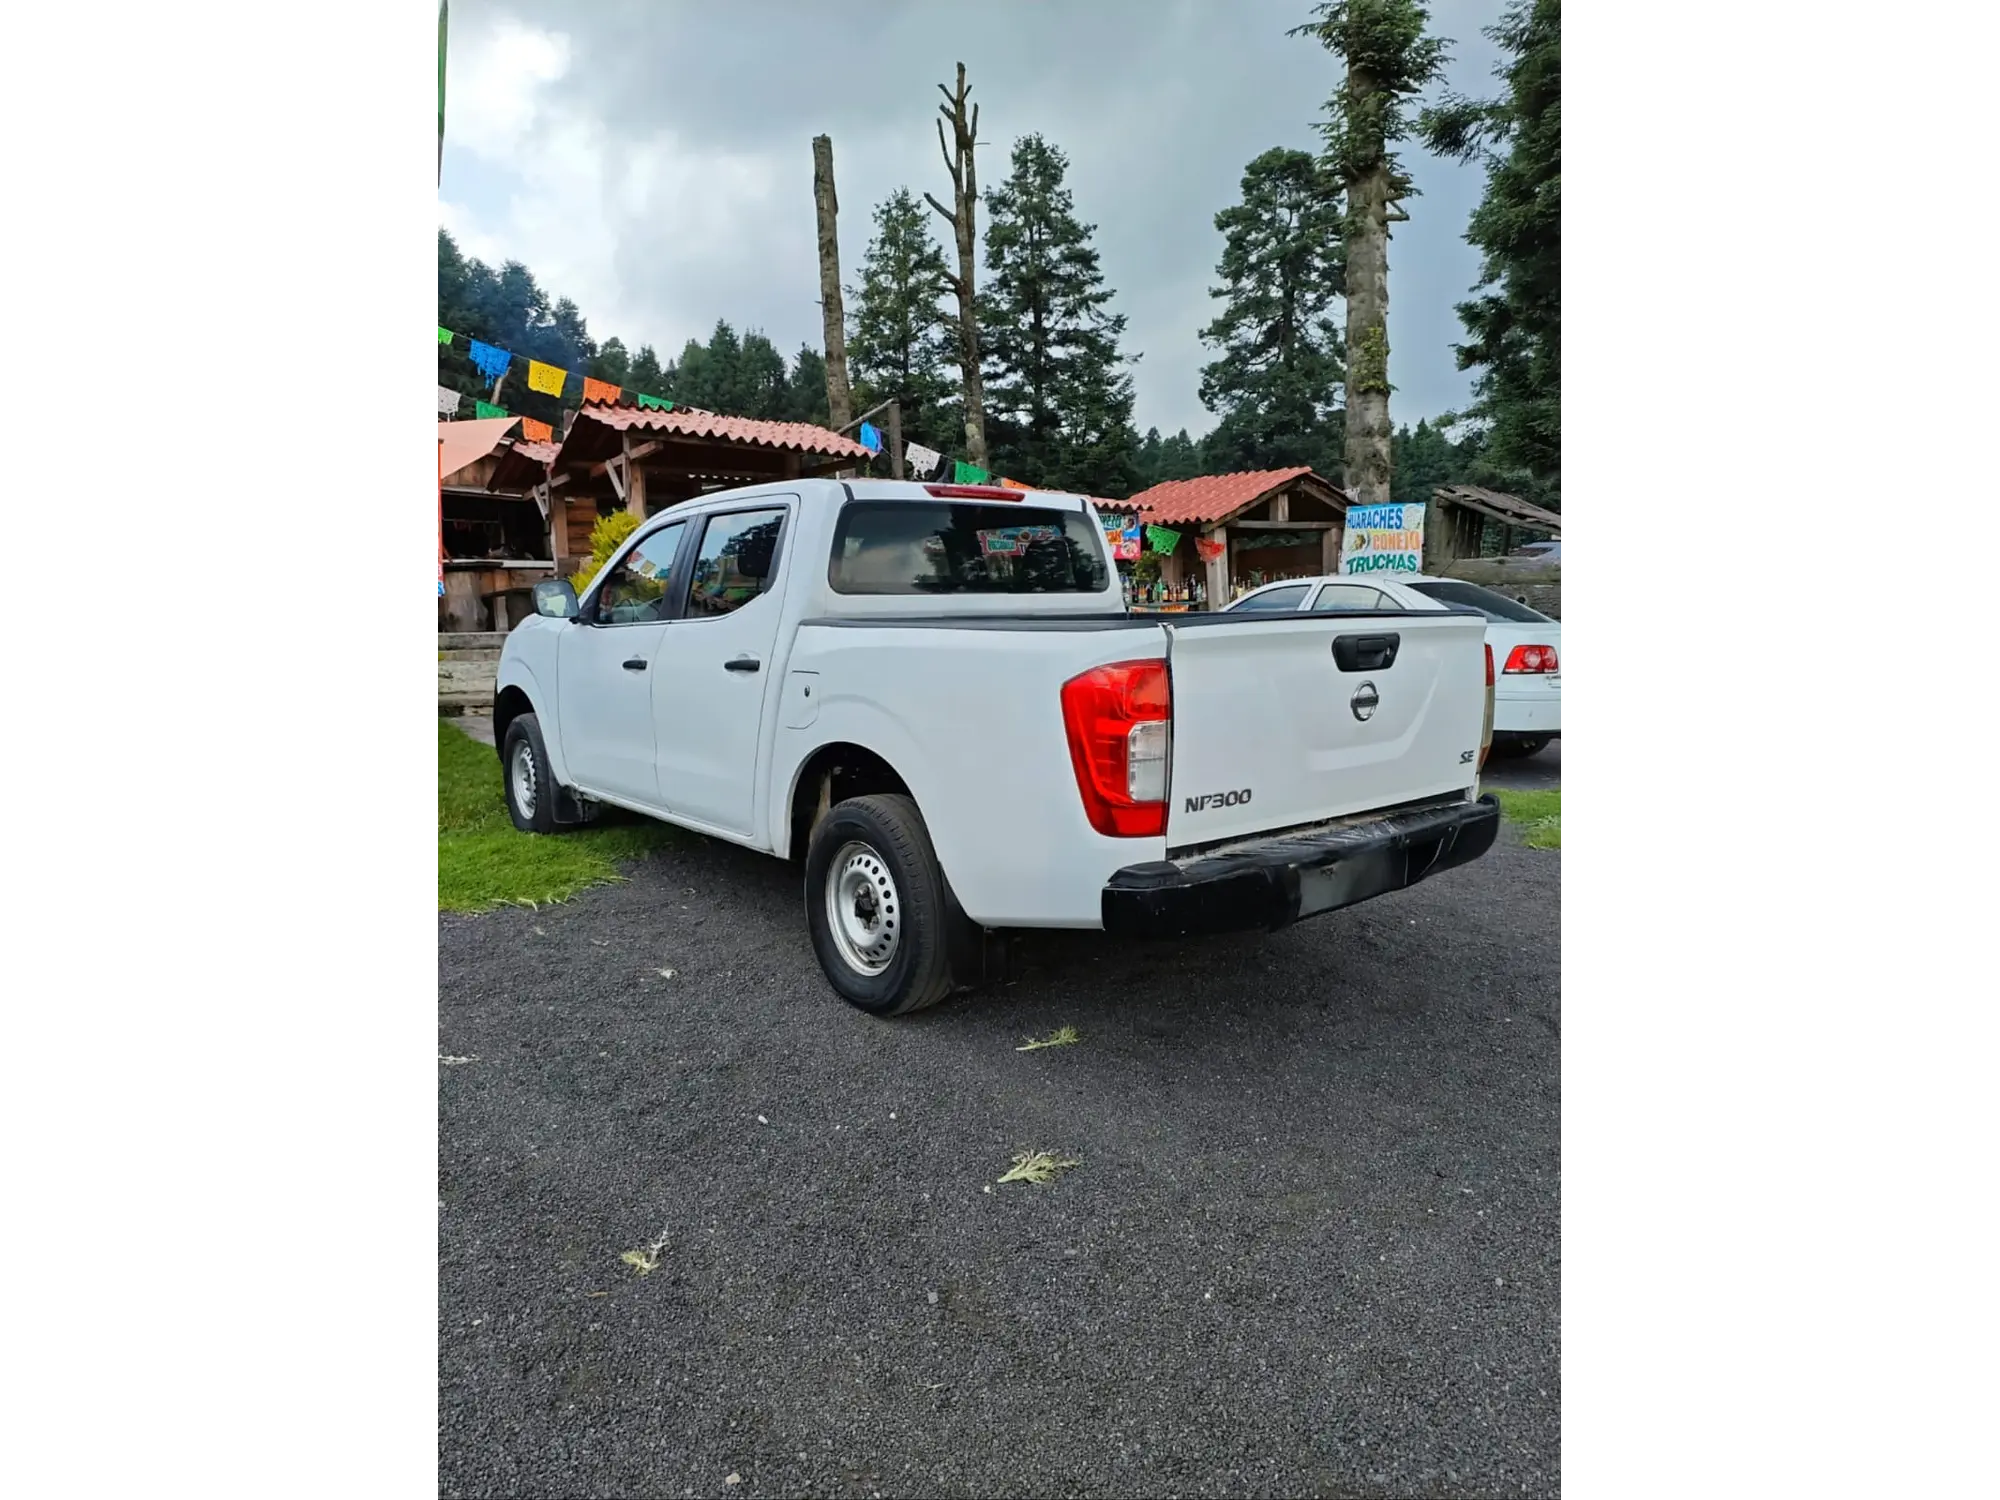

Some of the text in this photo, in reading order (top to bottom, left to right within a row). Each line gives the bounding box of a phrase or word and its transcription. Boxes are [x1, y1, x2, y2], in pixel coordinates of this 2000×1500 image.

[1347, 507, 1403, 529] HUARACHES
[1372, 531, 1419, 550] CONEJO
[1346, 553, 1417, 575] TRUCHAS
[1459, 750, 1474, 764] SE
[1185, 788, 1252, 813] NP300
